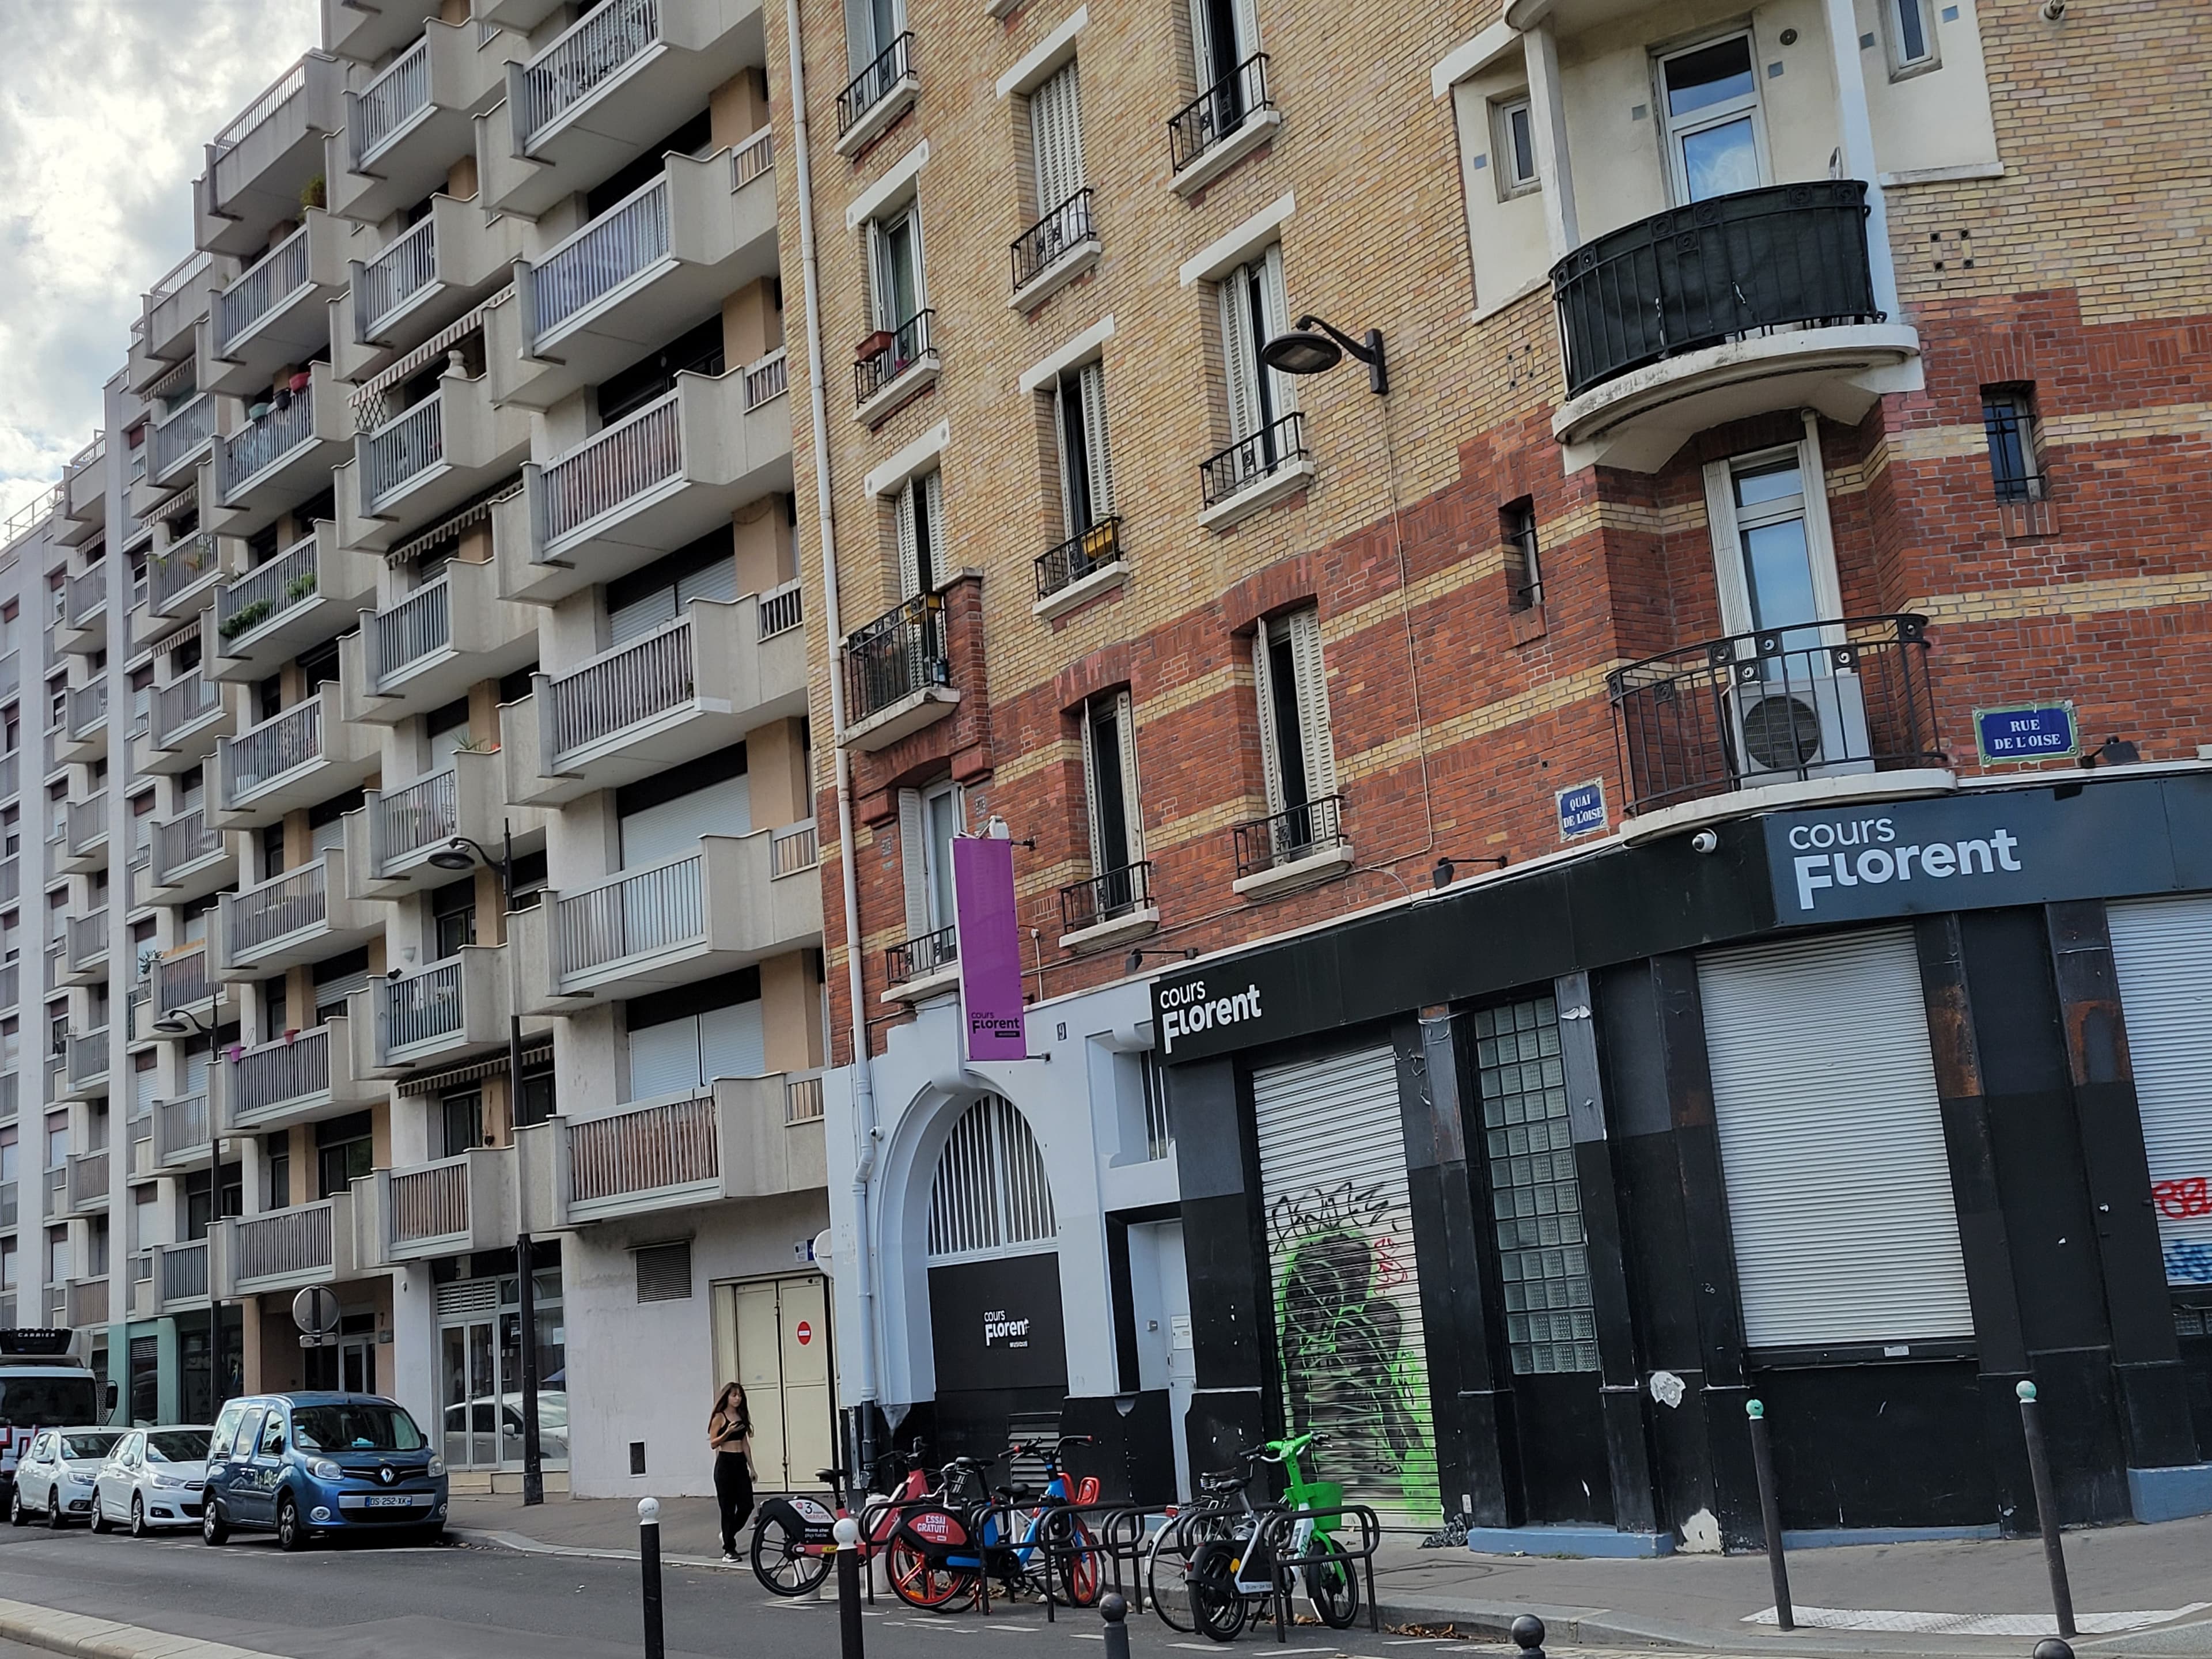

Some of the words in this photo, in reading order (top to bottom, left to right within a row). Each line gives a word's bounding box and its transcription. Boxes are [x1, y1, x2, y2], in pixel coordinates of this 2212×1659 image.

[2010, 719, 2040, 732] RUE
[1994, 738, 2013, 749] DE
[1570, 794, 1590, 811] QUAI
[1563, 816, 1575, 828] DE
[1577, 807, 1603, 824] L'OISE
[1789, 817, 1896, 850] cours
[1794, 828, 2022, 910] Florent
[1160, 981, 1206, 1009] cours
[972, 1017, 1020, 1034] Florent
[1162, 984, 1262, 1055] Florent
[1059, 1024, 1065, 1040] 9
[984, 1310, 1006, 1322] cours
[805, 1502, 812, 1514] 3
[926, 1515, 946, 1524] ESSAI
